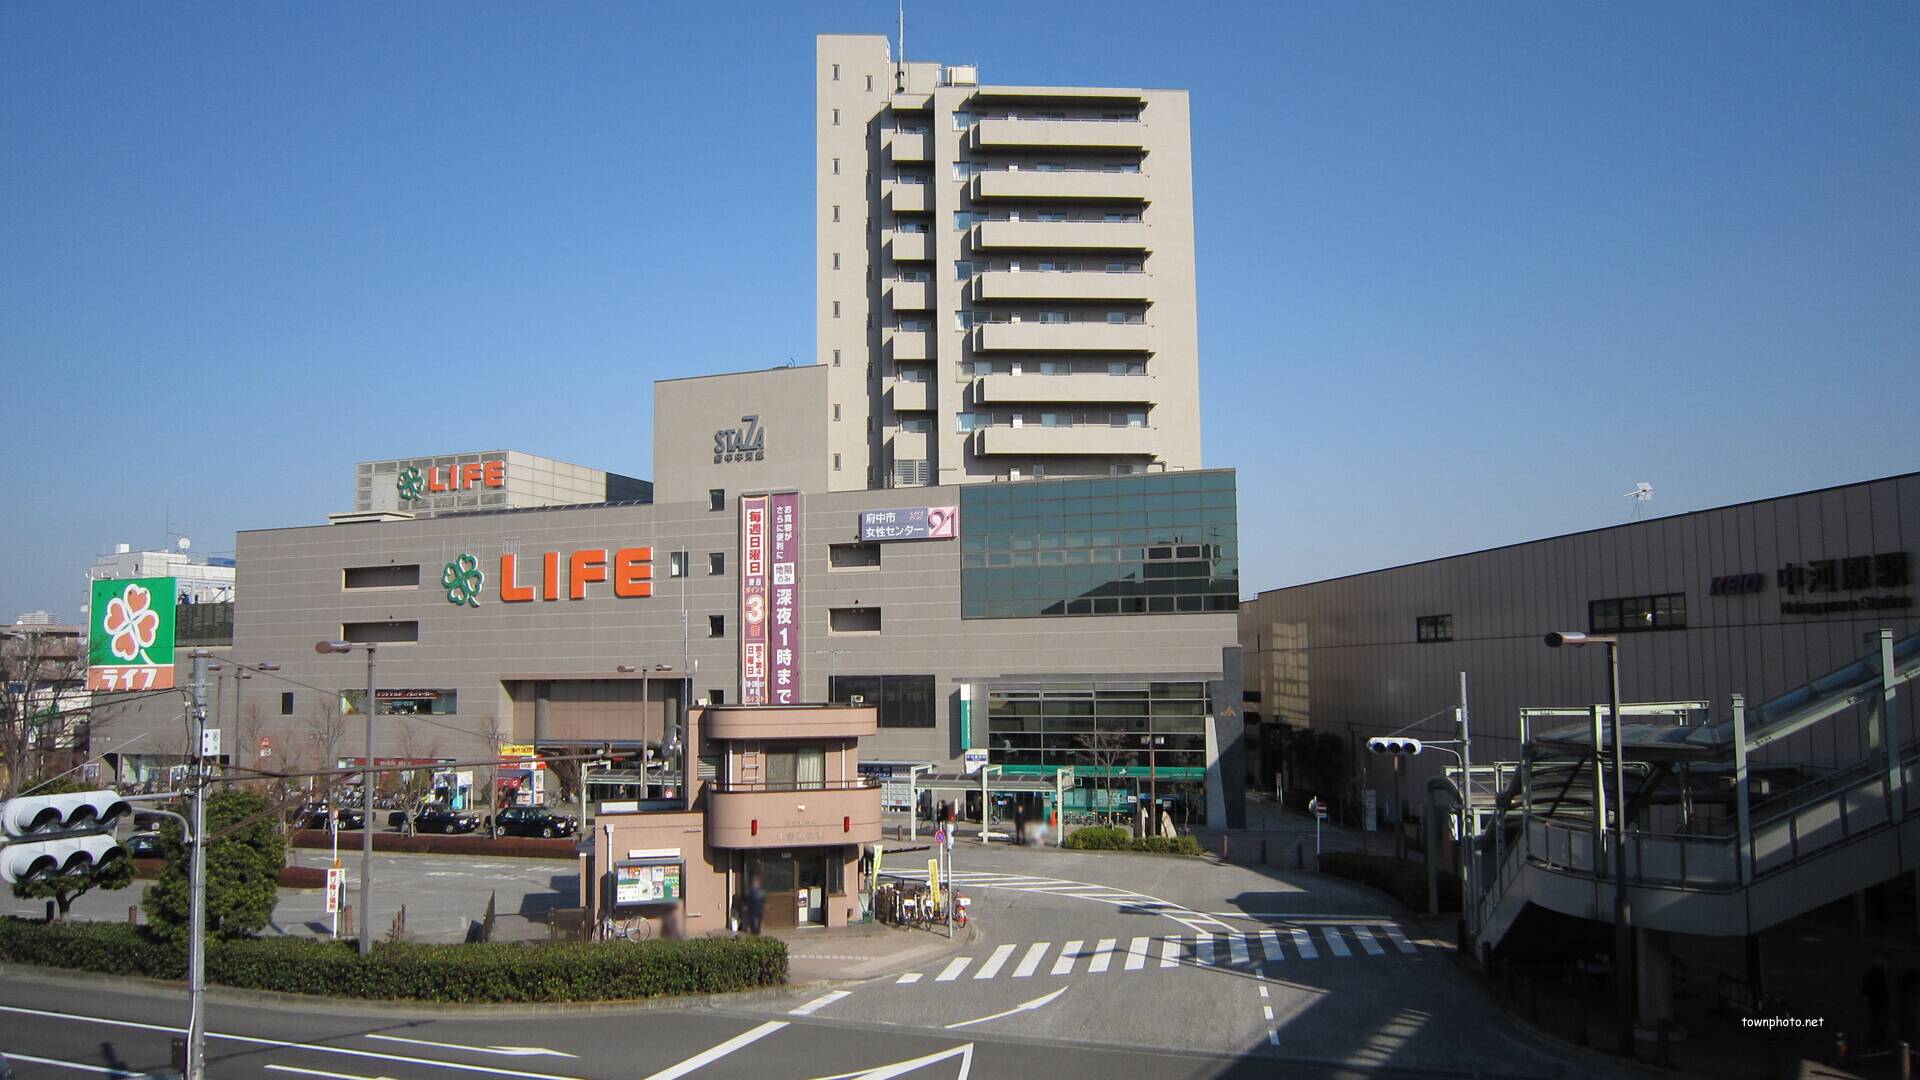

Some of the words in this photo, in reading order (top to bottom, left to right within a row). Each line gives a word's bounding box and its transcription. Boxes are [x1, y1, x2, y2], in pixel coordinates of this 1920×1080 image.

[714, 415, 764, 453] STAZA
[428, 460, 505, 492] LIFE
[776, 505, 785, 560] さらに便利に
[784, 505, 792, 541] お買物が
[865, 511, 897, 524] 府中市
[865, 525, 925, 538] 女性センター
[748, 511, 762, 574] 毎週日曜日
[500, 547, 654, 603] LIFE
[1776, 552, 1908, 594] 中河原駅
[776, 588, 793, 704] 深夜1時まで
[102, 668, 157, 692] ライフ
